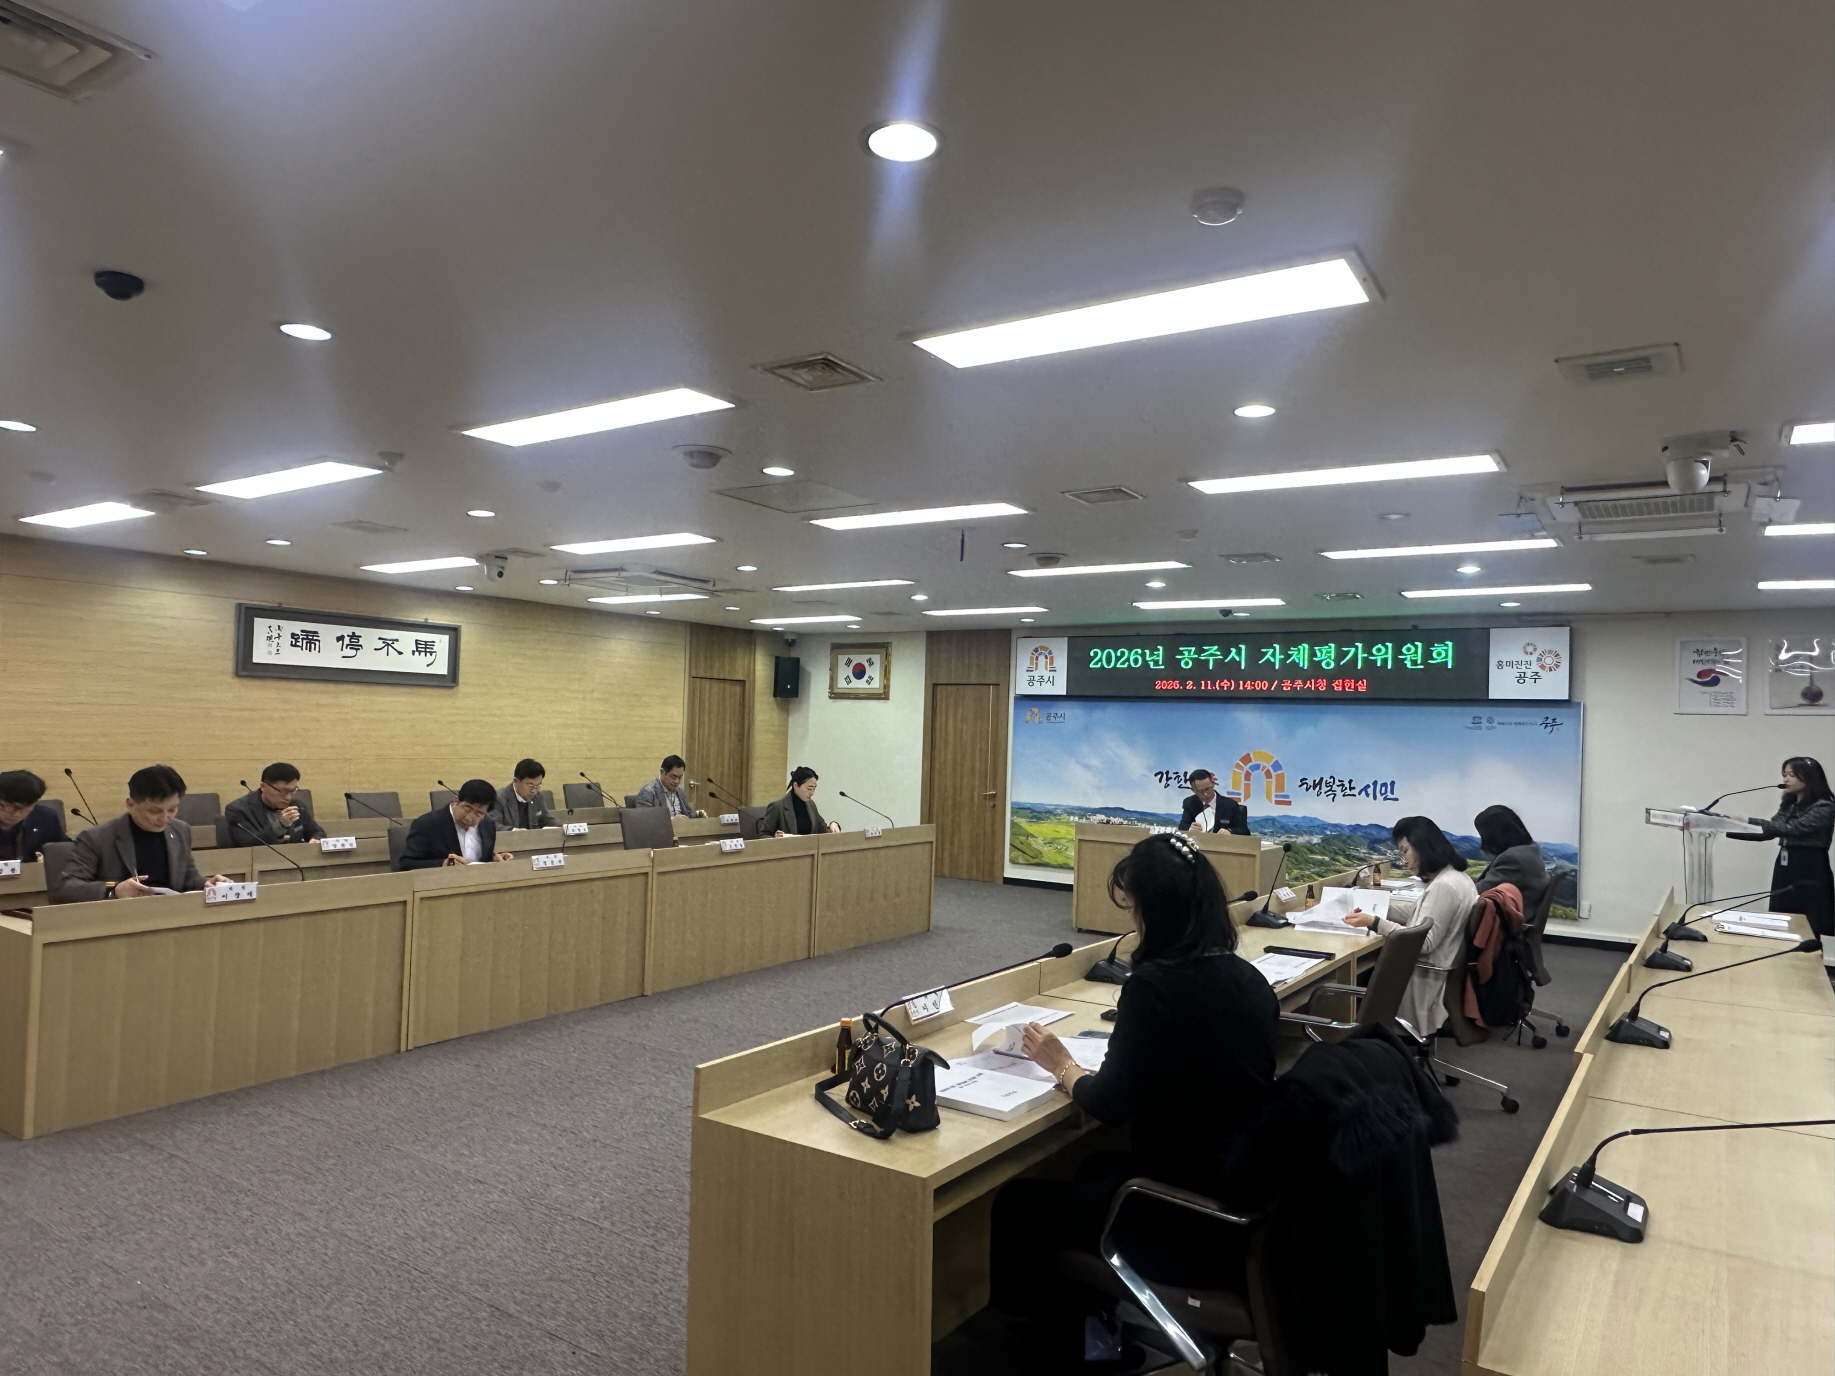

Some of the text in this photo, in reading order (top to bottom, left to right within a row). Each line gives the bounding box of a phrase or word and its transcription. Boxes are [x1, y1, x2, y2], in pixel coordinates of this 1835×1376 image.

[1089, 641, 1454, 670] 2026년 공주시 자체평가위원회
[1026, 675, 1055, 687] 공주시
[1155, 680, 1183, 690] 2026.
[1186, 681, 1196, 690] 2.
[1238, 680, 1269, 691] 14:00
[1281, 679, 1327, 691] 공주시청
[1514, 672, 1543, 685] 공주
[1298, 775, 1400, 802] 행복한 시민
